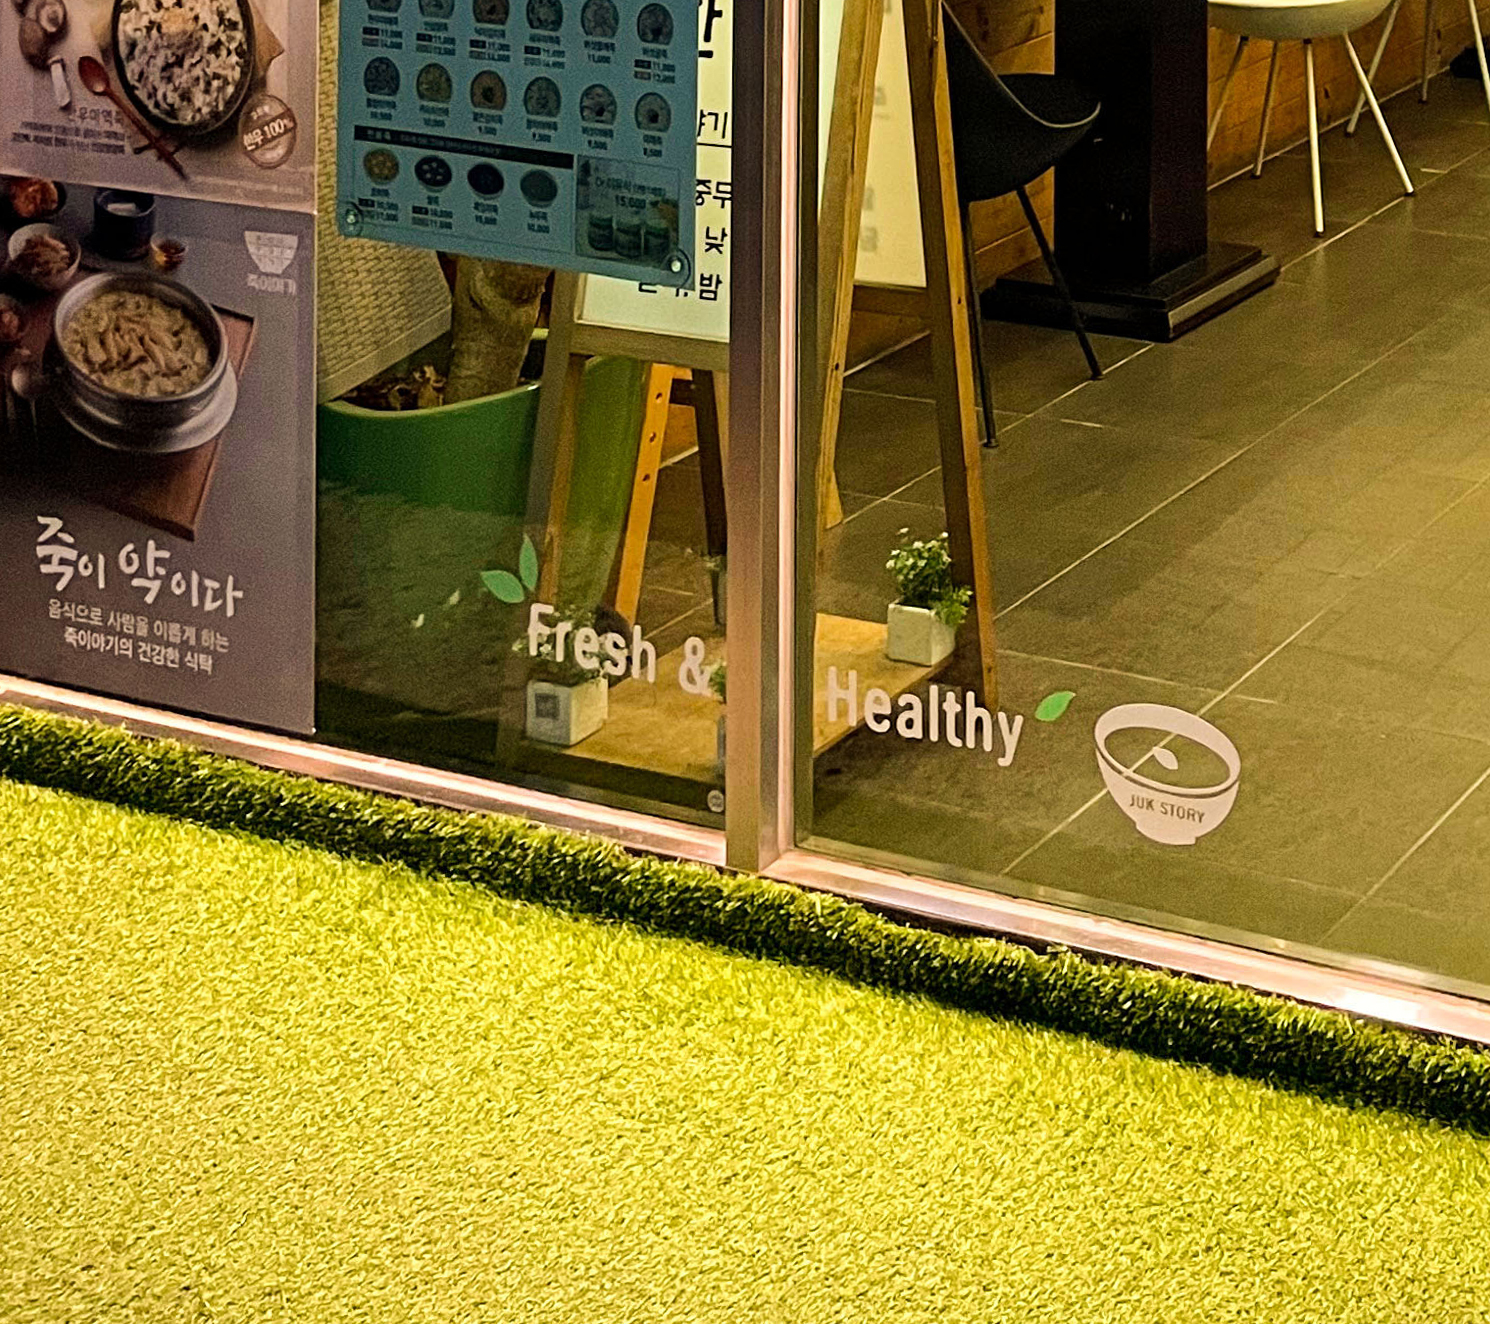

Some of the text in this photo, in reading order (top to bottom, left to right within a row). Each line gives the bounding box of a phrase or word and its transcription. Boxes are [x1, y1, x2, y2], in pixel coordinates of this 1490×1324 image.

[36, 515, 244, 618] 죽이 약이다
[48, 598, 104, 626] 음식으로
[107, 610, 150, 638] 사람을
[201, 628, 230, 653] 하는
[64, 626, 214, 675] 죽이야기의 건강한 식탁
[525, 602, 1024, 766] Fresh & Healthy
[1128, 793, 1206, 825] JUK STORY
